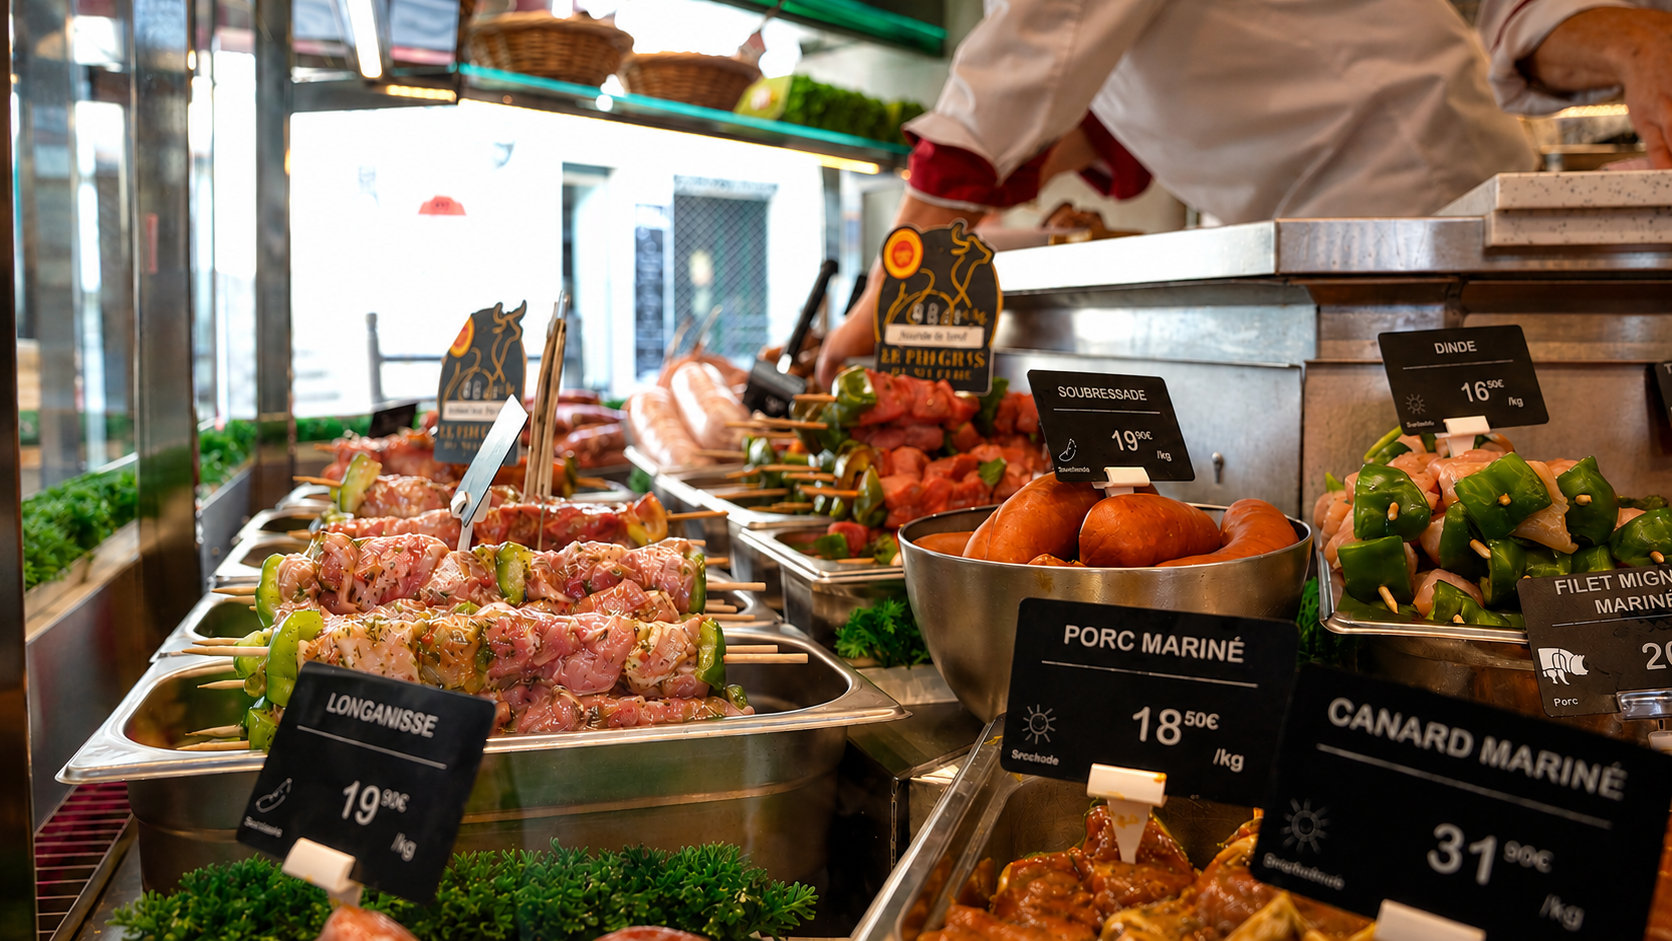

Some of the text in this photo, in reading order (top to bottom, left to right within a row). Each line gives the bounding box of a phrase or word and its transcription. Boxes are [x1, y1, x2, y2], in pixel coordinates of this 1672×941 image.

[1434, 340, 1477, 354] DINDE
[1057, 385, 1147, 401] SOUBRESSADE
[1508, 397, 1524, 408] /kg
[1156, 450, 1172, 462] /kg
[1554, 574, 1613, 595] FILET
[1063, 624, 1244, 663] PORC MARINÉ
[1553, 698, 1579, 707] Porc
[326, 692, 439, 738] LONGANISSE
[1212, 748, 1245, 773] /kg
[1327, 697, 1628, 801] CANARD MARINÉ
[390, 832, 418, 862] /kg
[1539, 894, 1586, 933] /kg
